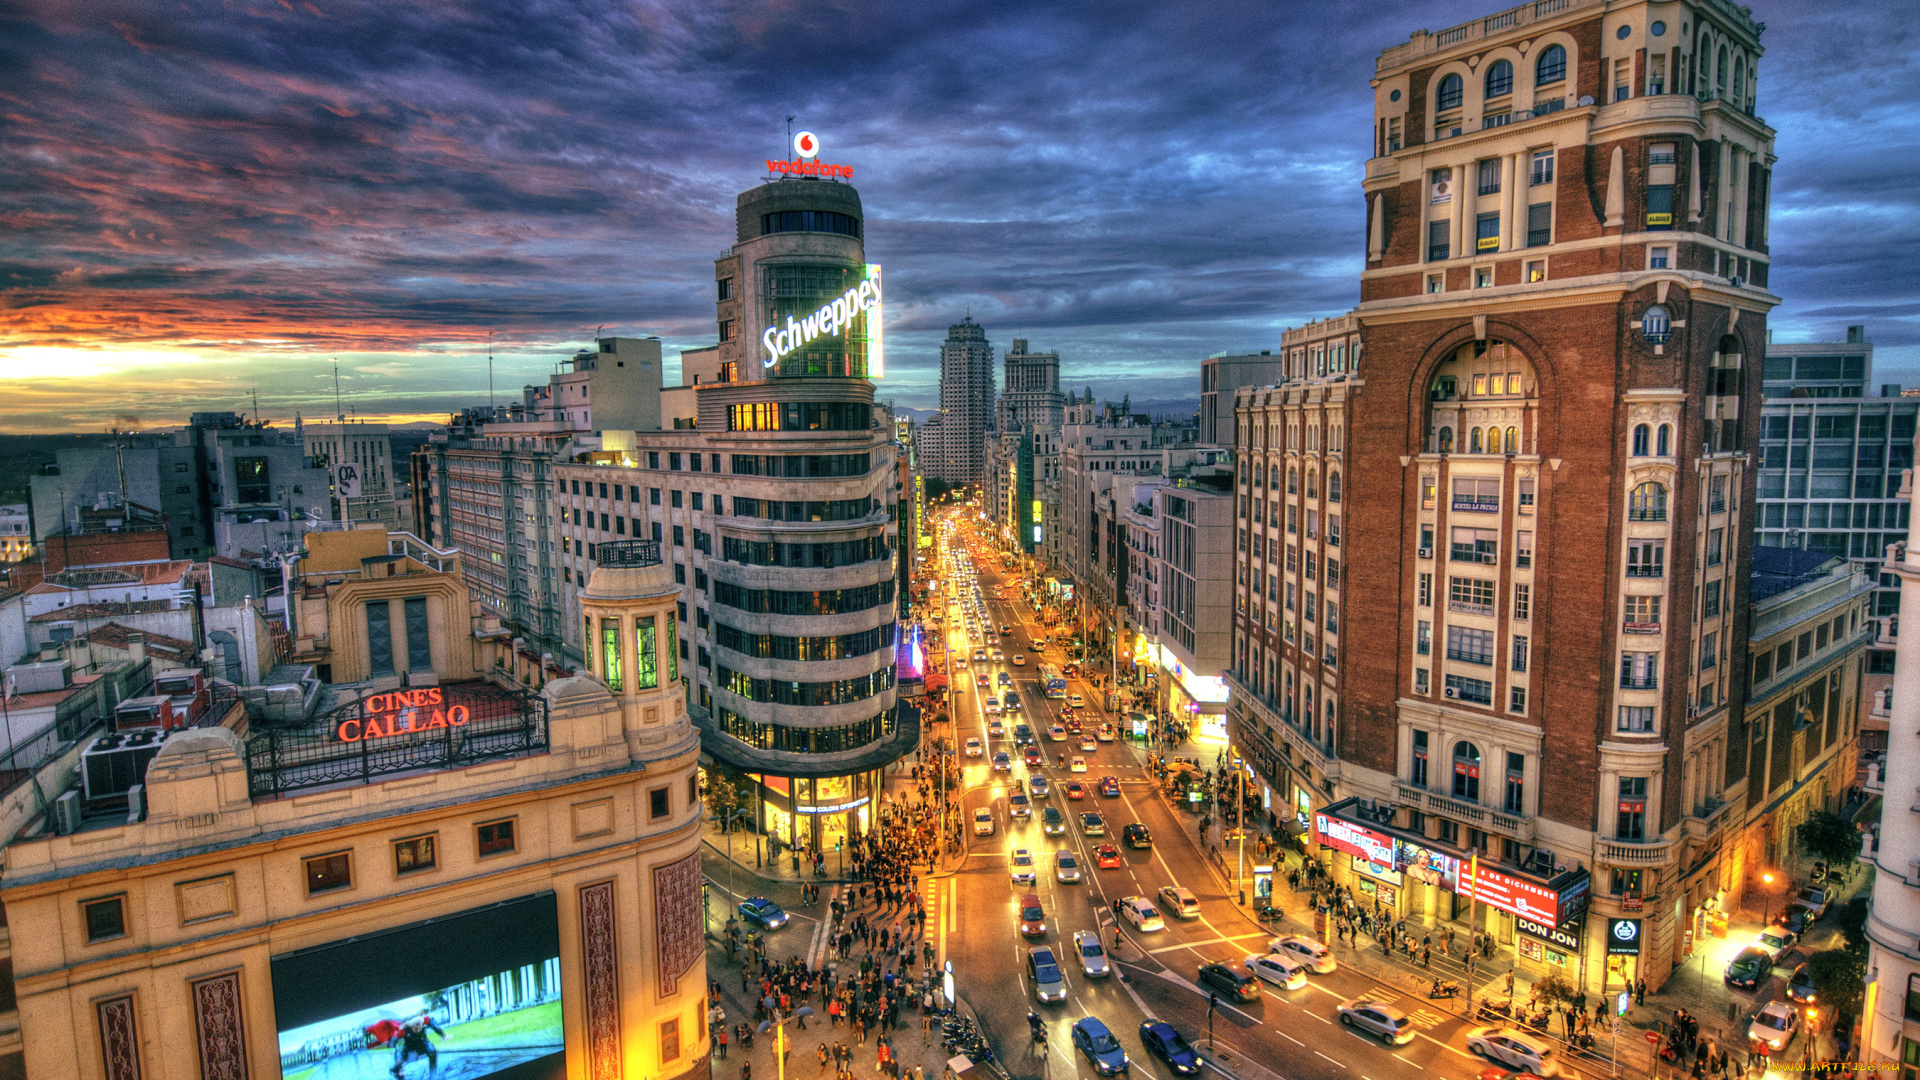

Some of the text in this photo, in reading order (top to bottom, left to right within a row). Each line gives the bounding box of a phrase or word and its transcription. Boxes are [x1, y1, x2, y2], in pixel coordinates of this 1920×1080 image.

[766, 158, 854, 178] vodafone
[763, 272, 881, 368] Schweppes
[366, 688, 444, 714] CINES
[338, 705, 469, 742] CALLAO
[1505, 878, 1554, 900] DICIEMBRE
[1519, 919, 1577, 947] DON JON
